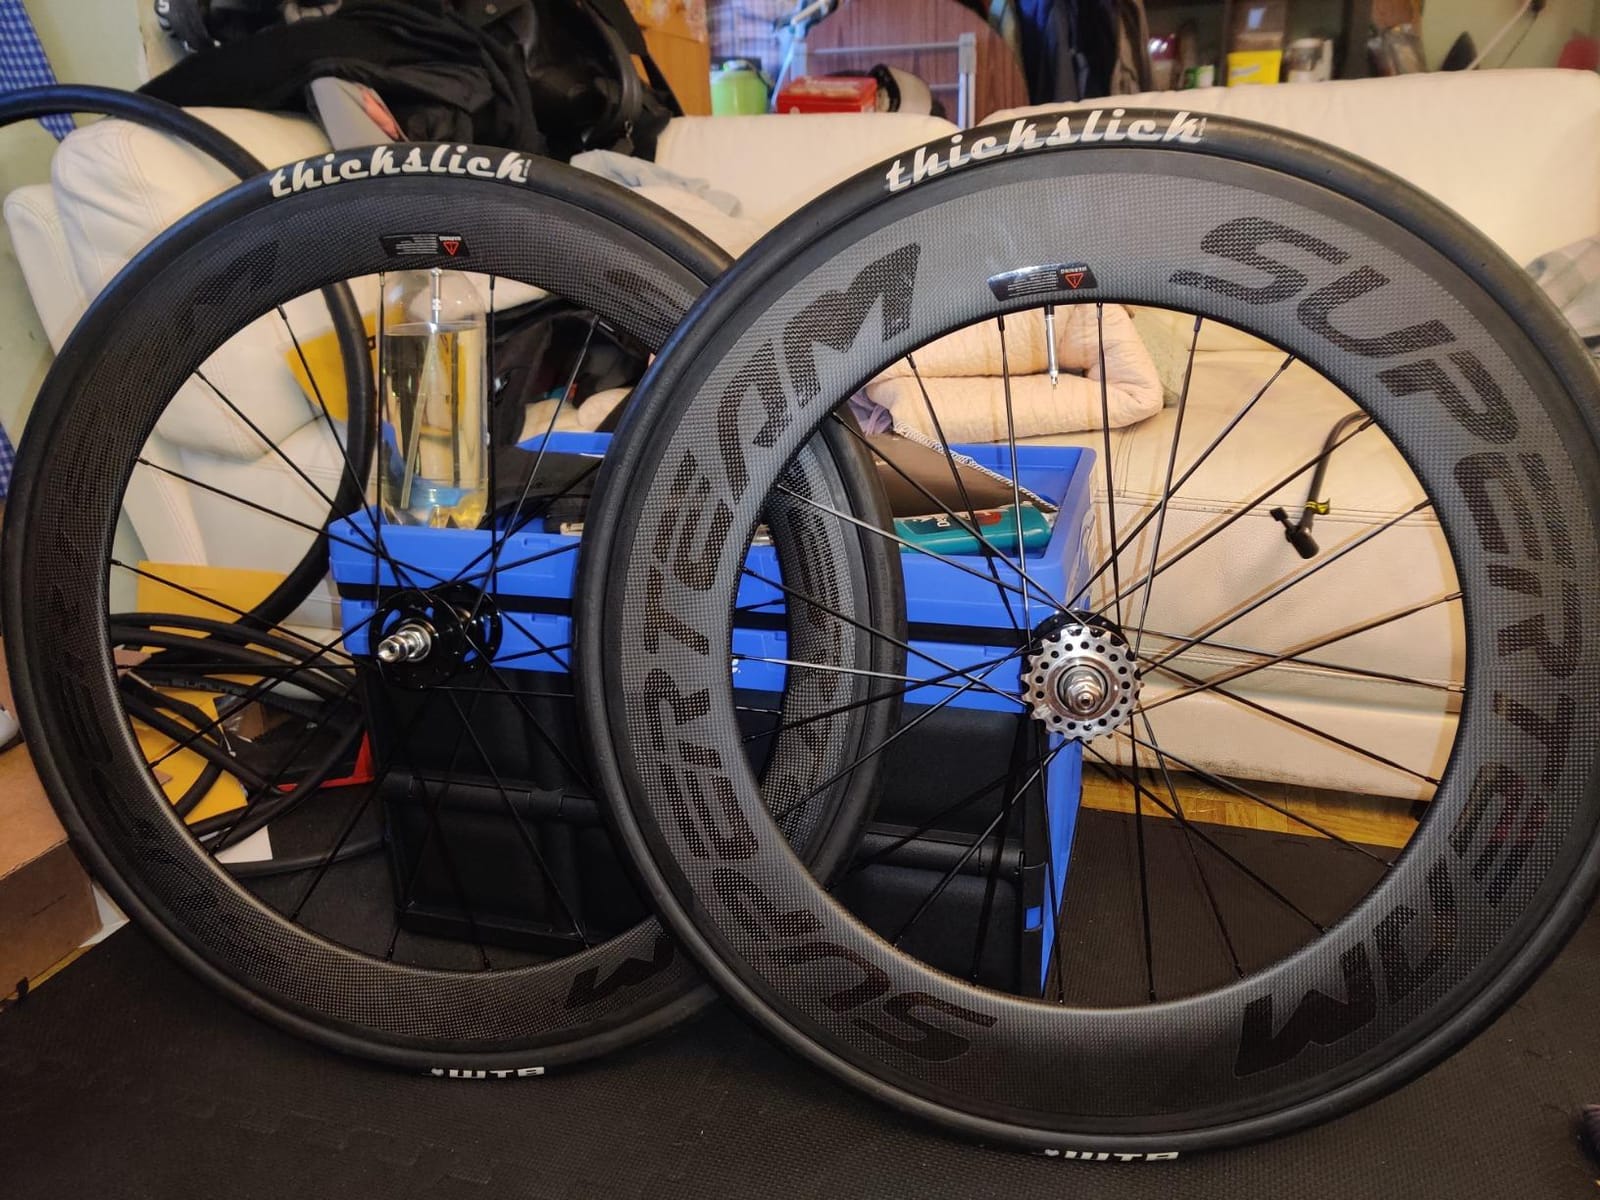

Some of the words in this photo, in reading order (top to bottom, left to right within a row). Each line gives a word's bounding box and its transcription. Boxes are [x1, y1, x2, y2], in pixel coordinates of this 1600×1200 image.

[269, 144, 527, 198] thickslick
[886, 108, 1202, 192] thickslick
[643, 242, 998, 1064] SUPERTEAM
[1170, 216, 1582, 1077] SUPERTEAM
